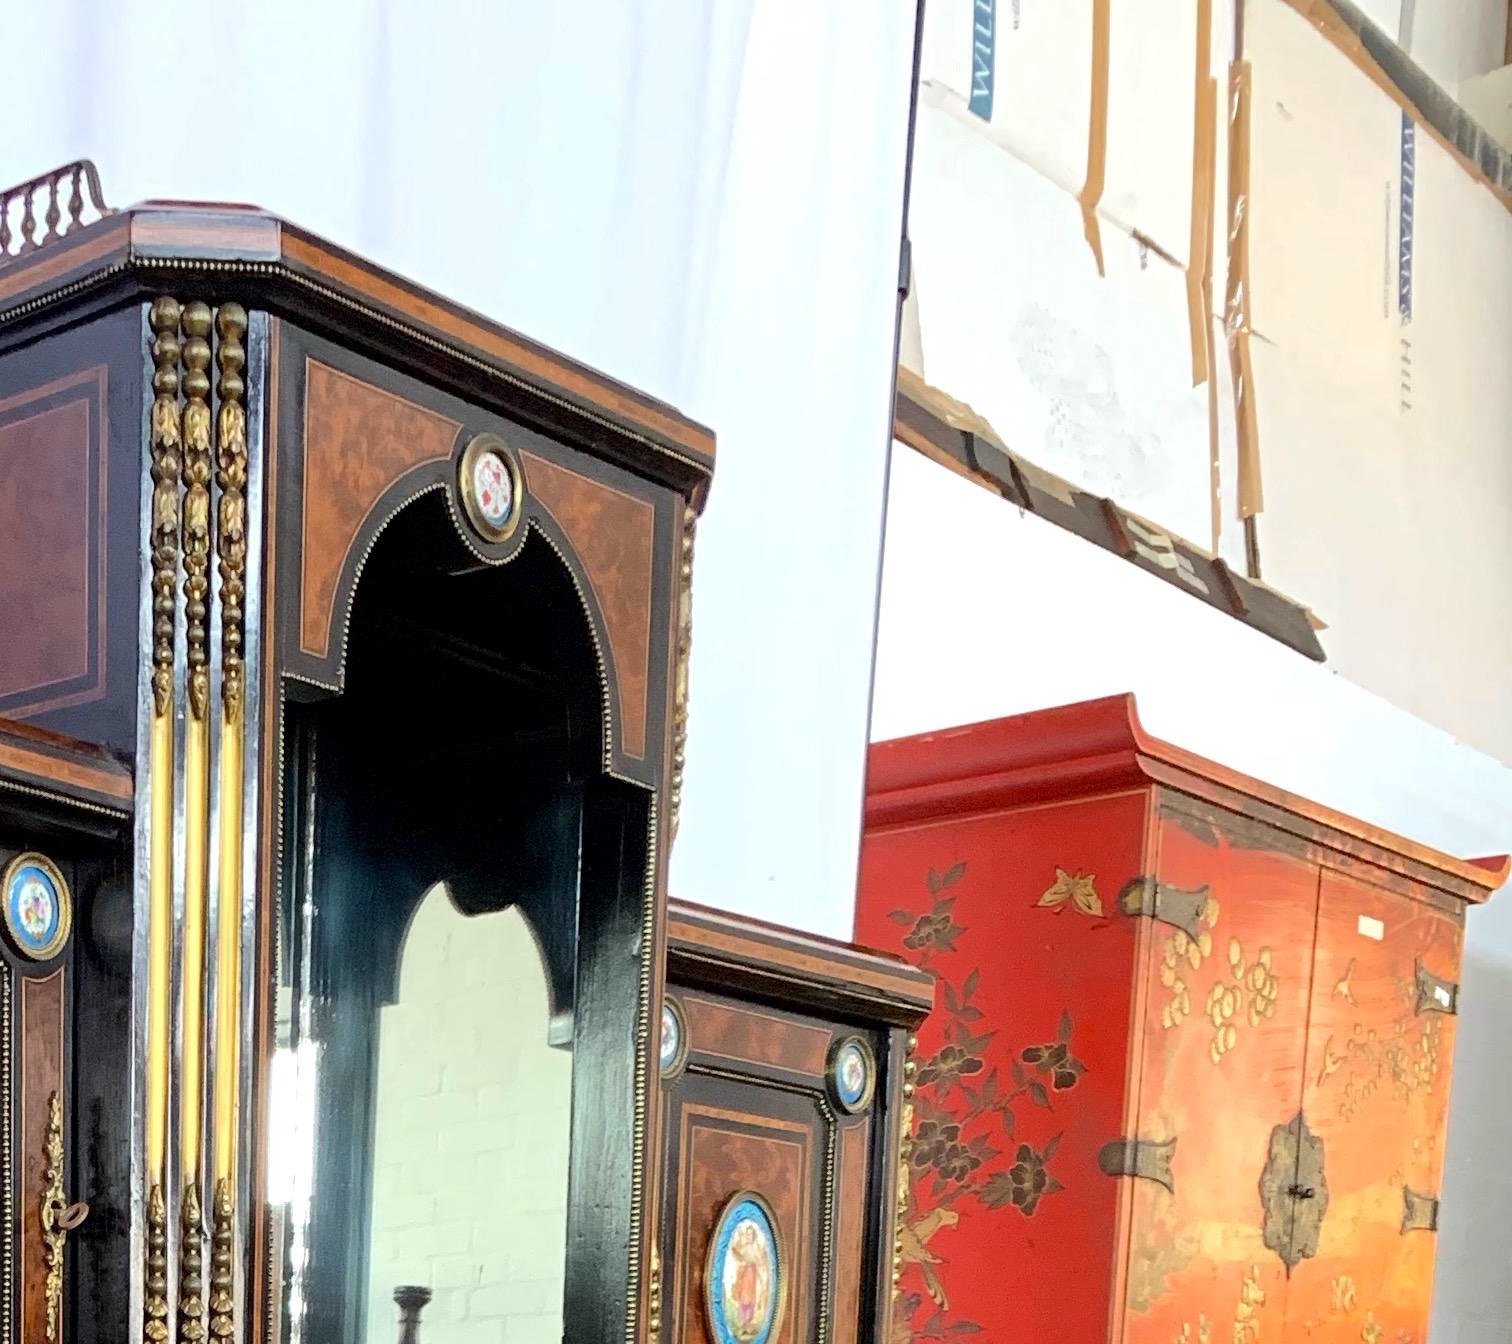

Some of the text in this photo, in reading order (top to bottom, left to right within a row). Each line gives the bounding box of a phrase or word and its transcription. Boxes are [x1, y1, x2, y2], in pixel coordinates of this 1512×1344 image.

[1399, 128, 1414, 413] WILLIAMS & HILL
